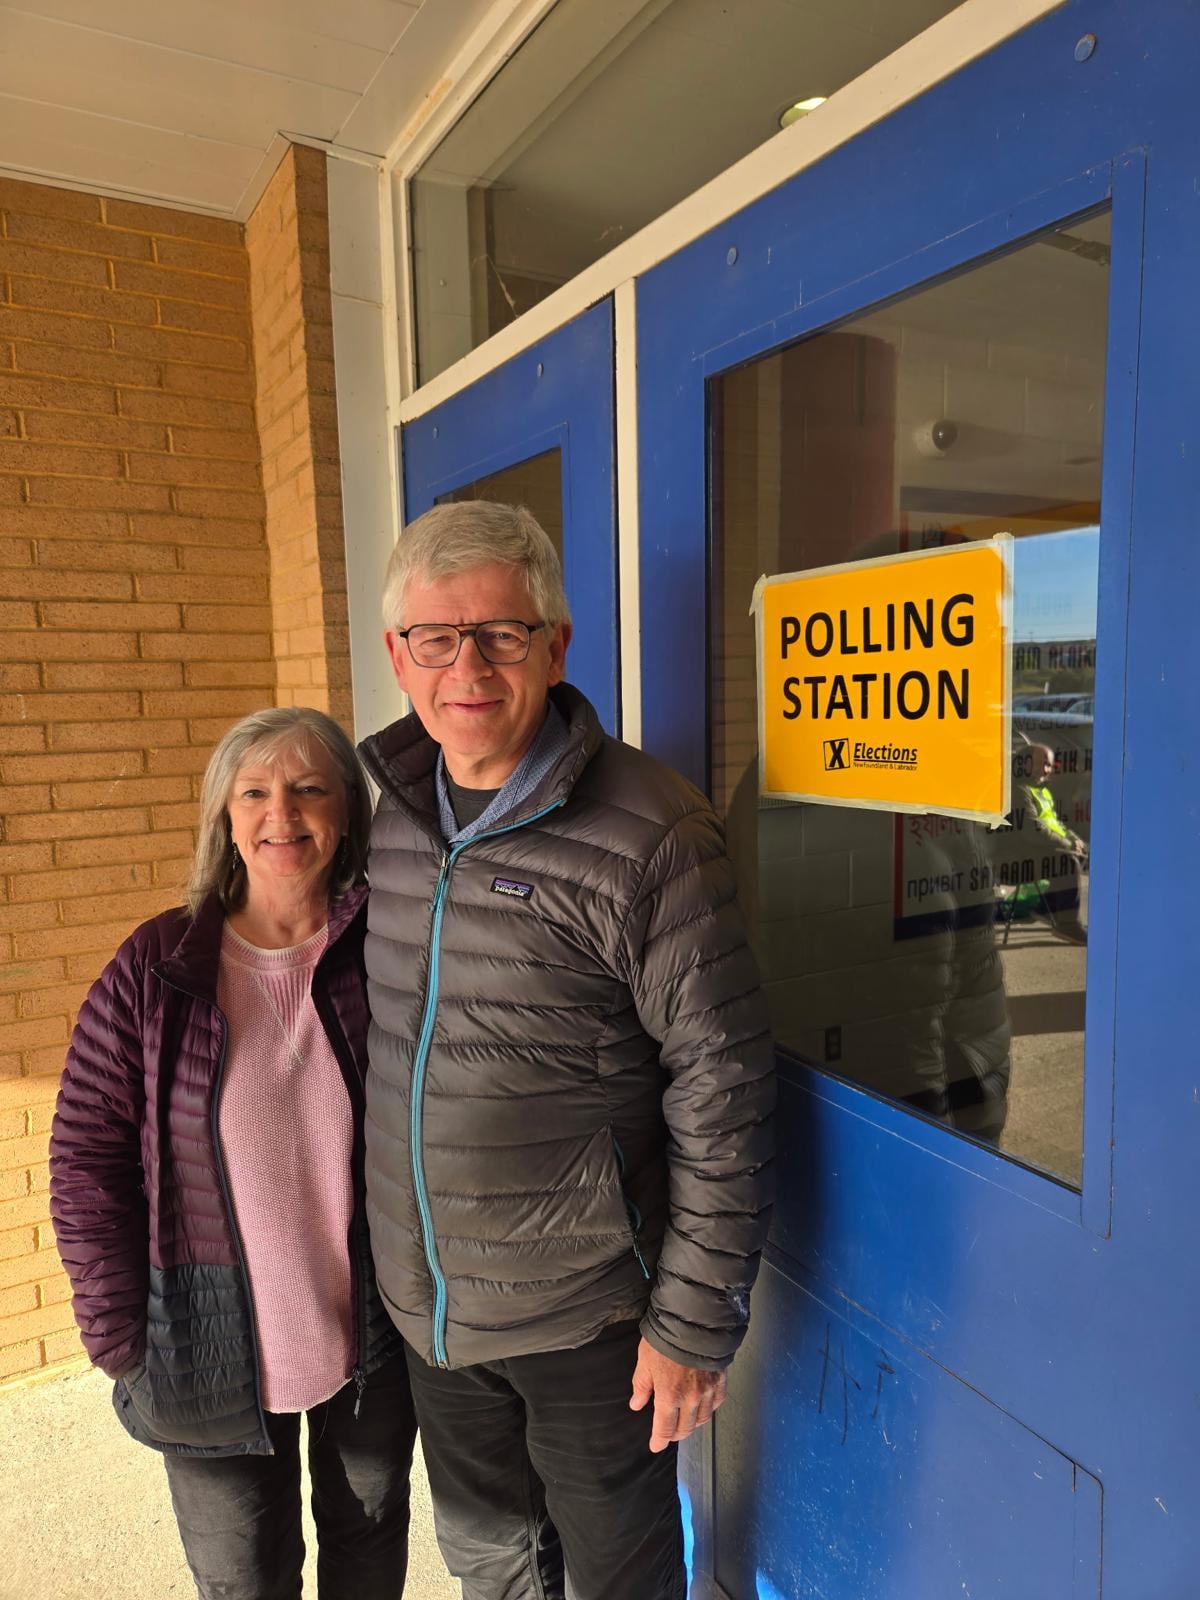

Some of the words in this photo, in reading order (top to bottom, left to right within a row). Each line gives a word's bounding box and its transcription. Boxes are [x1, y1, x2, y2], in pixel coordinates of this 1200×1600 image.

[780, 592, 974, 660] POLLING
[782, 669, 969, 721] STATION
[853, 742, 918, 761] Elections
[970, 858, 1034, 891] SAAAM
